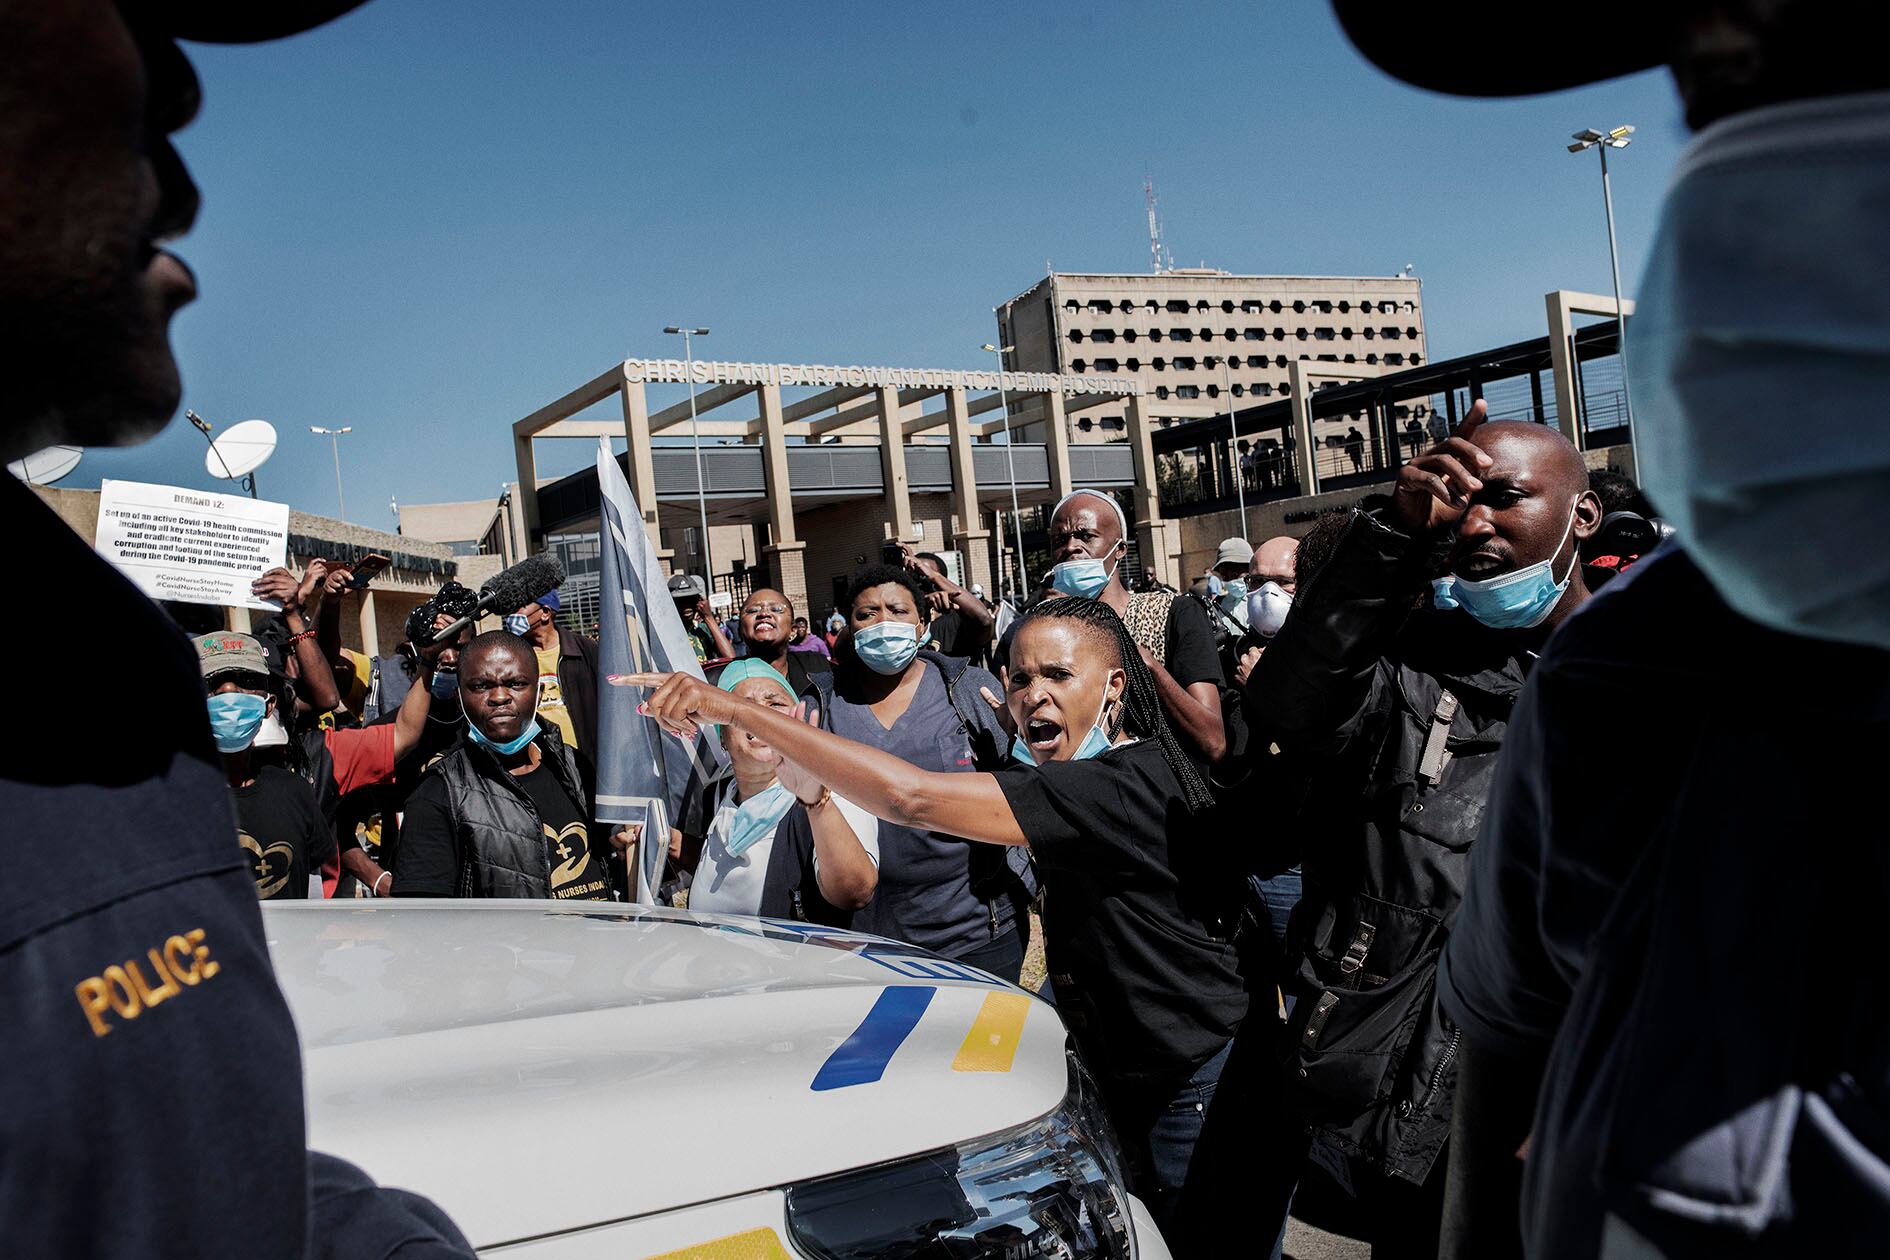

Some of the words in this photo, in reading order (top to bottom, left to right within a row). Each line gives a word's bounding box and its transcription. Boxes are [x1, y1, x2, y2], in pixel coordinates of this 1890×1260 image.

[623, 358, 708, 384] CHRIS
[712, 361, 774, 386] HANI
[777, 363, 954, 388] BARAGWANATH
[957, 369, 1059, 392] ACADEMIC
[1062, 375, 1142, 396] HOSPITAL
[174, 494, 210, 507] DEMAND
[213, 501, 225, 509] 12:
[105, 509, 119, 518] Set
[120, 511, 131, 520] up
[132, 512, 140, 520] of
[153, 514, 177, 523] active
[178, 517, 212, 528] Covid-19
[213, 521, 237, 532] health
[238, 526, 283, 538] commission
[127, 531, 143, 539] and
[144, 532, 182, 543] eradicate
[183, 537, 212, 547] current
[214, 541, 260, 553] experienced
[158, 525, 168, 534] all
[170, 525, 184, 535] key
[185, 528, 231, 540] stakeholder
[232, 533, 240, 541] to
[241, 534, 269, 546] identify
[114, 539, 157, 551] corruption
[175, 545, 203, 556] looting
[204, 548, 212, 556] of
[213, 550, 225, 558] the
[227, 552, 248, 562] setup
[249, 554, 270, 564] funds
[120, 549, 147, 560] during
[149, 552, 162, 560] the
[163, 553, 197, 564] Covid-19
[198, 558, 236, 569] pandemic
[557, 884, 588, 899] NURSES
[74, 928, 221, 1037] POLICE
